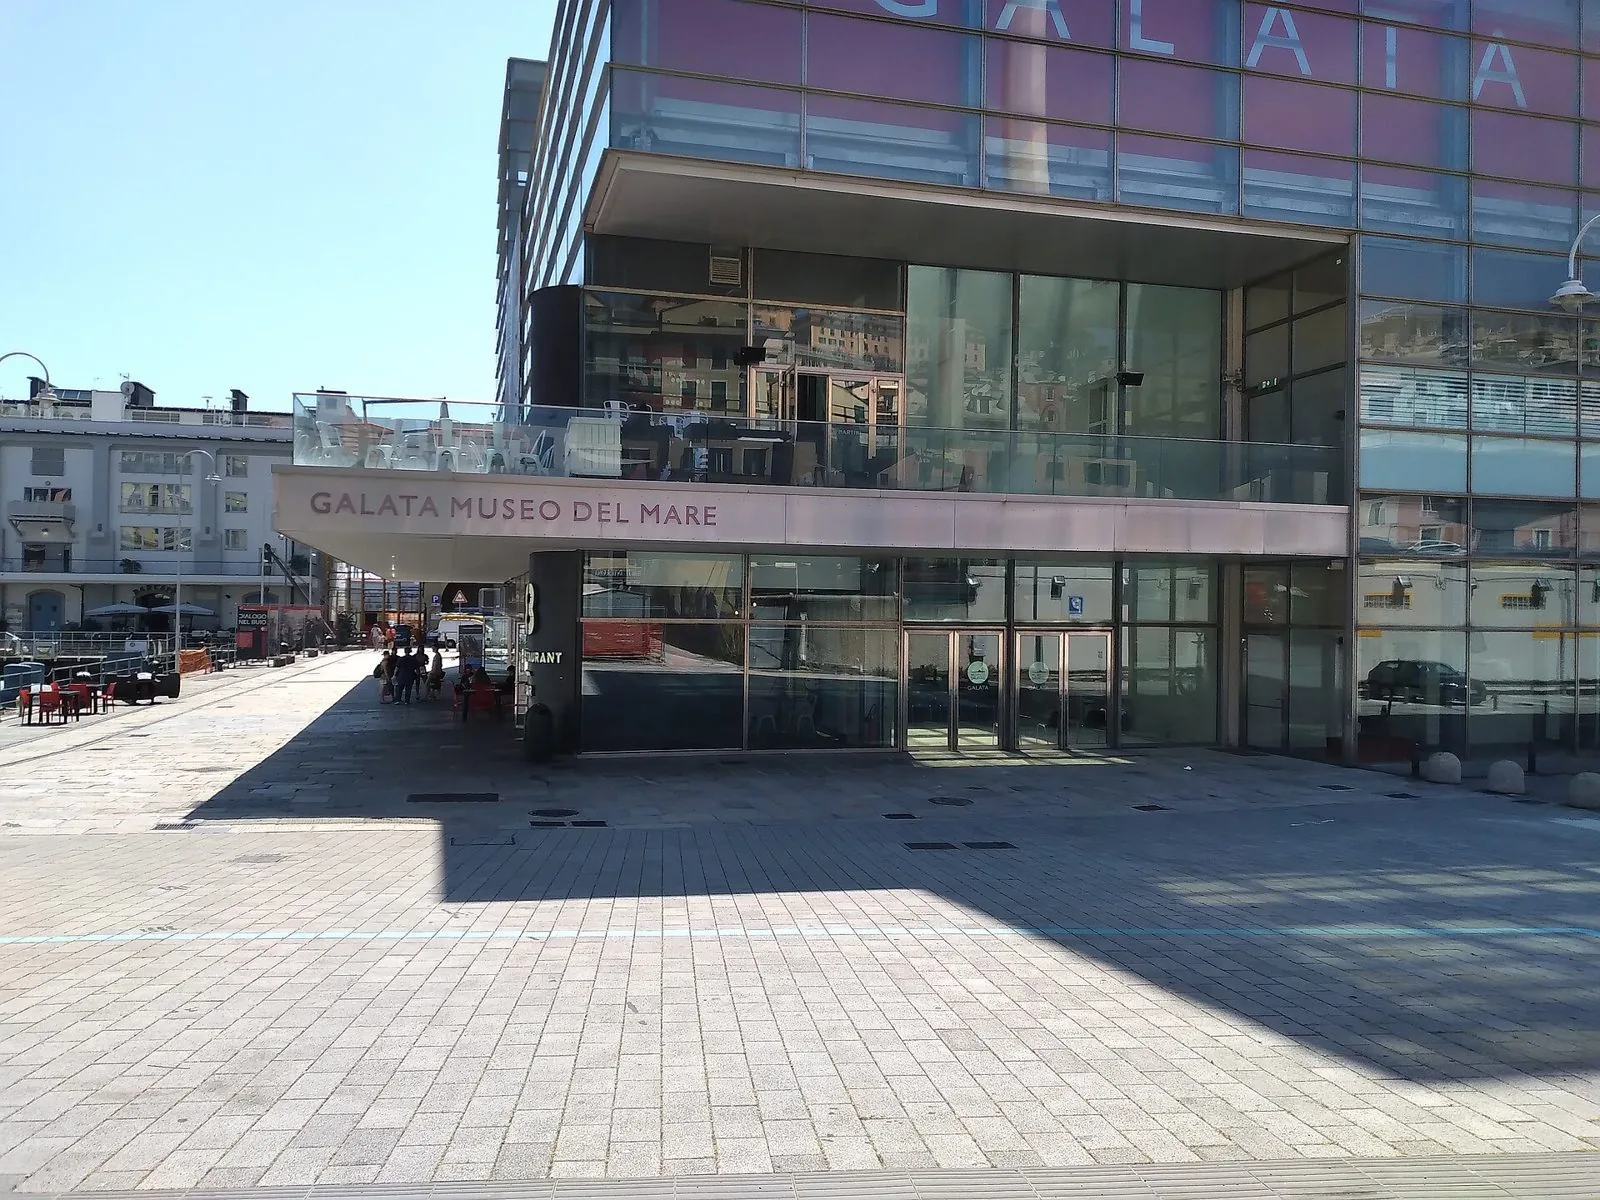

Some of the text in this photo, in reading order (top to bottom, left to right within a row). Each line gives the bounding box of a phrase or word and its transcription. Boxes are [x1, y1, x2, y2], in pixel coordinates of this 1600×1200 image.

[873, 0, 1528, 109] ALATA
[310, 491, 717, 526] GALATA MUSEO DEL MARE
